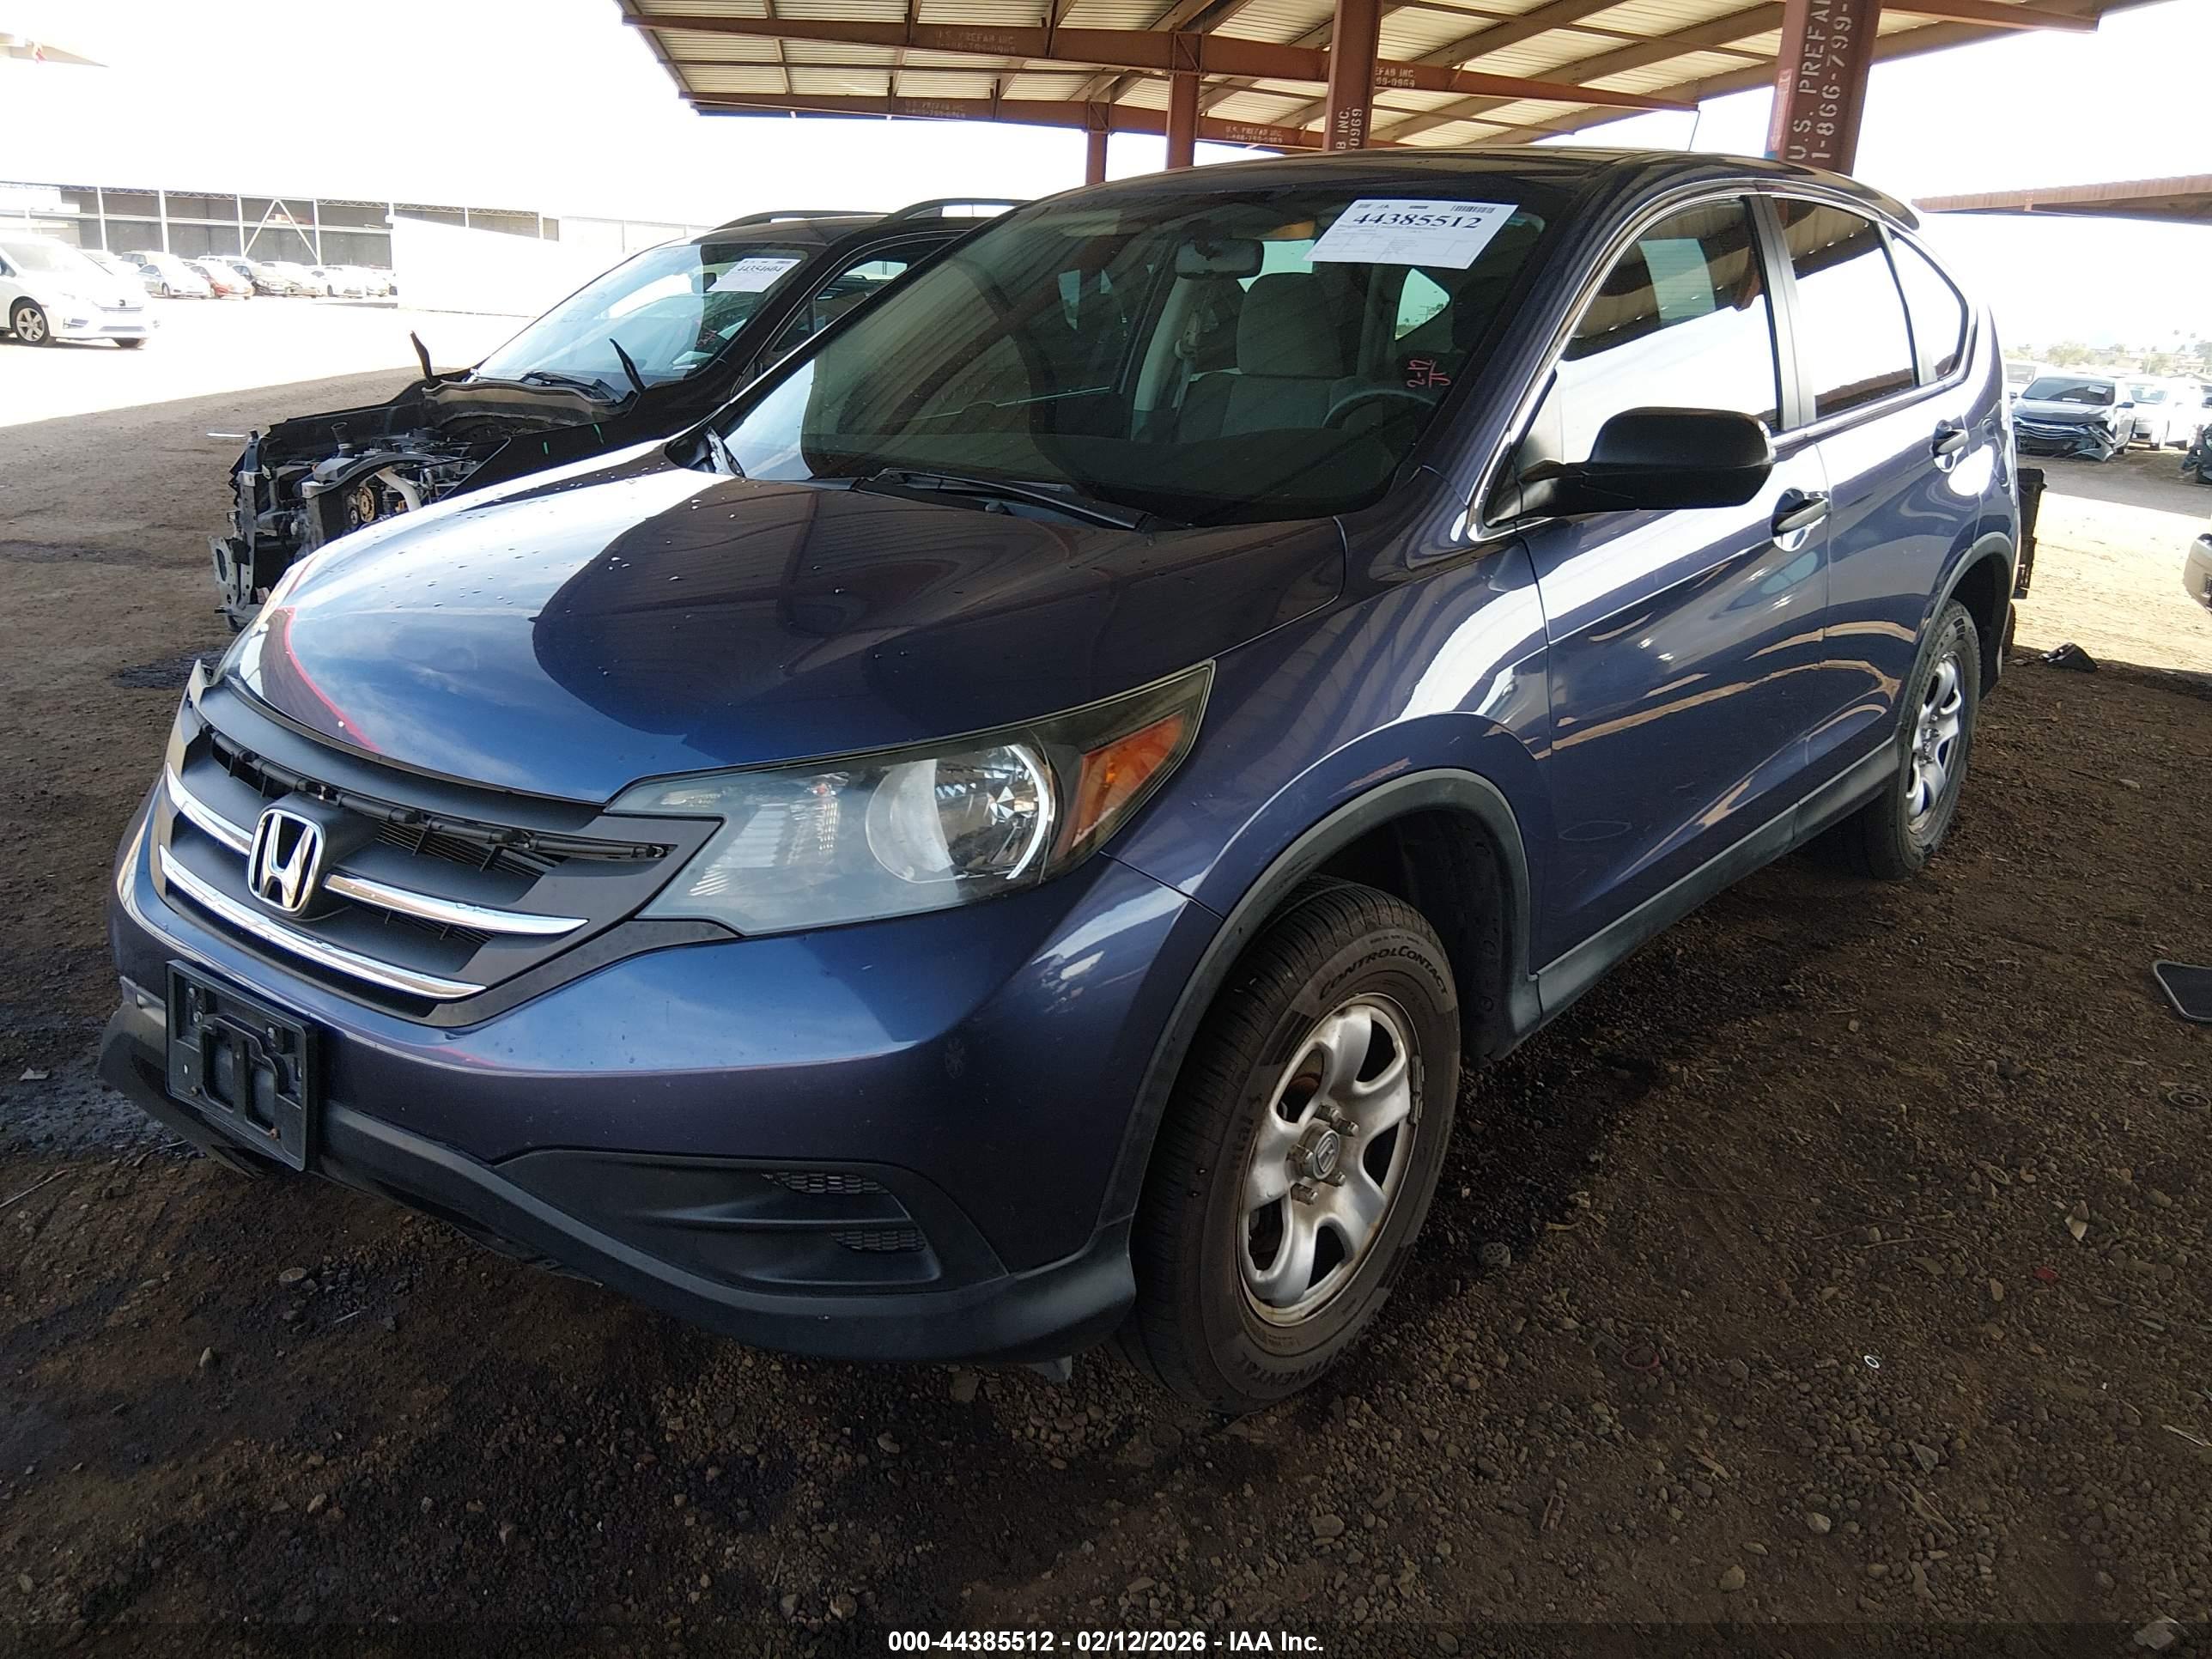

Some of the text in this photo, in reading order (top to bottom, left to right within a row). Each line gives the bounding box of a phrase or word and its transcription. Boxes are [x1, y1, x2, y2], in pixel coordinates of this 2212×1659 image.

[1375, 66, 1396, 77] EFAB
[1376, 76, 1416, 88] 99-0969
[1787, 0, 1832, 161] U.S. PREFA
[1811, 3, 1853, 160] 1-866-799-
[1337, 106, 1351, 134] INC.
[1348, 108, 1364, 151] -0969
[1352, 212, 1483, 229] 44385512
